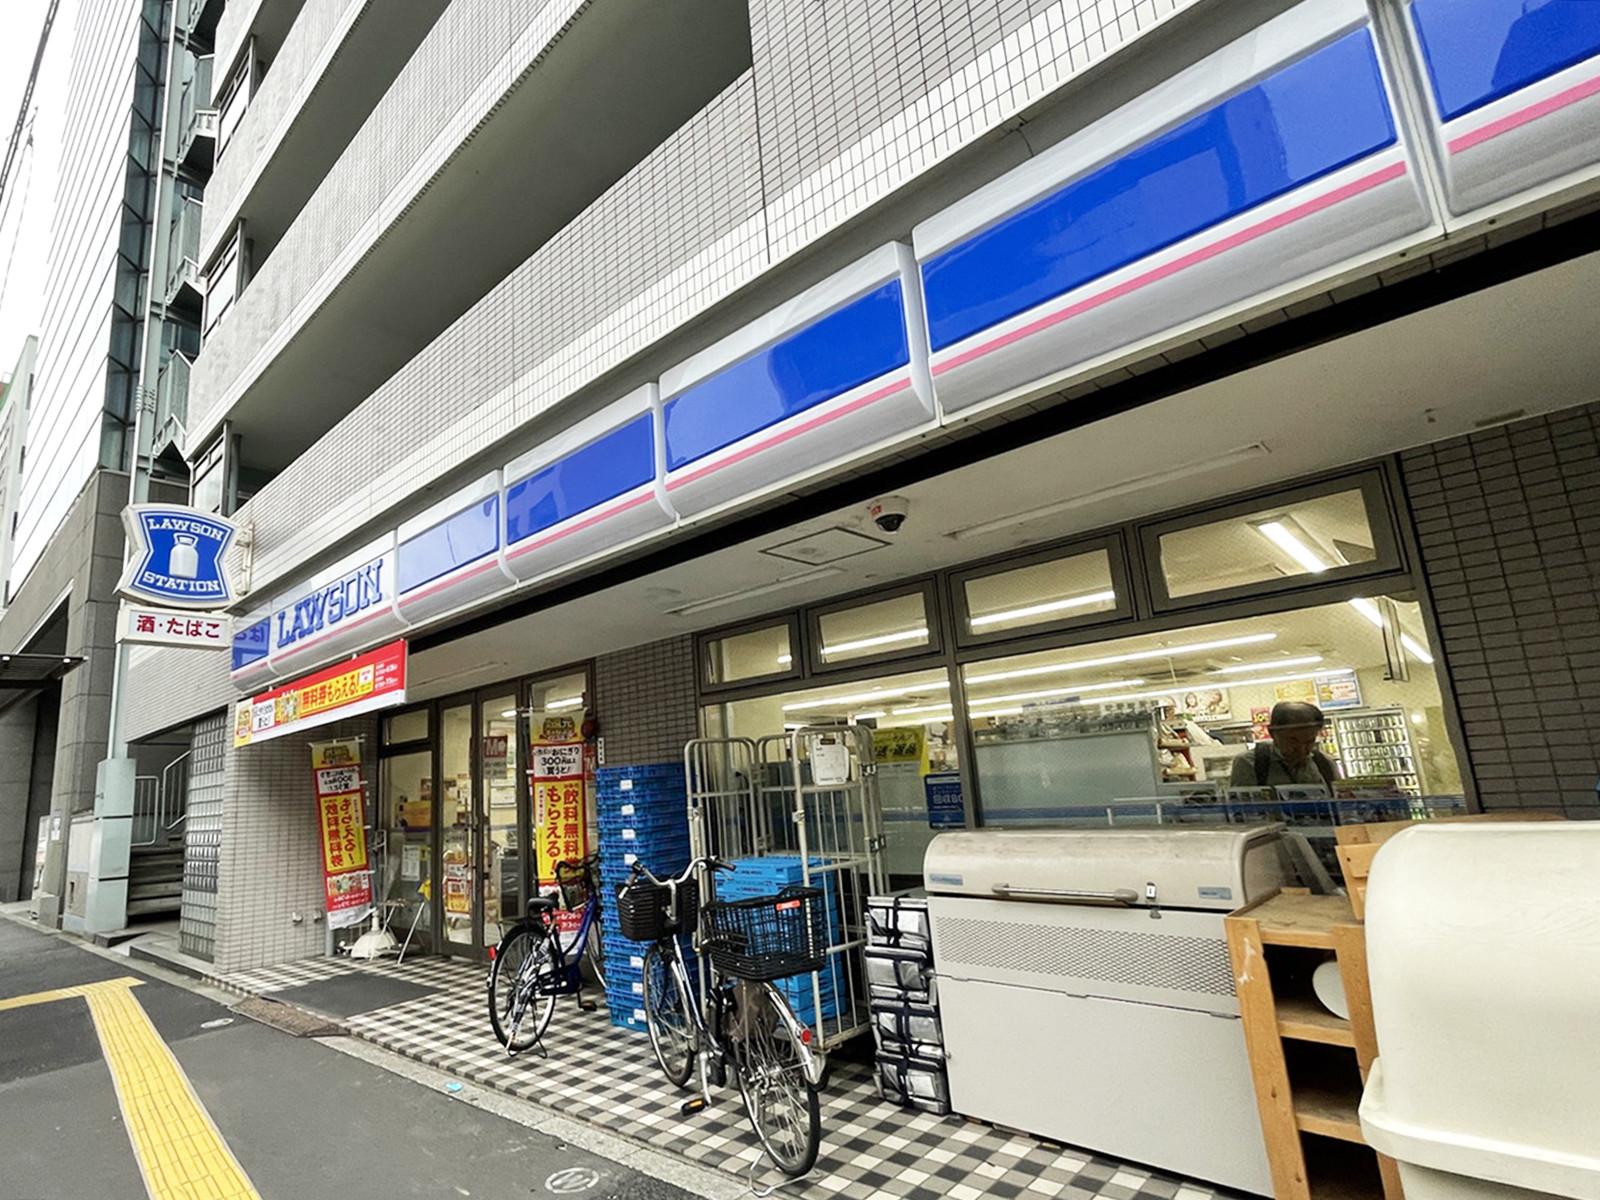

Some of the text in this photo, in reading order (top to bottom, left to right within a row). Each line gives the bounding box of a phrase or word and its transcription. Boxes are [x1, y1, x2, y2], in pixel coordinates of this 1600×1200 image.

[147, 517, 225, 542] LAWSON
[142, 570, 222, 593] STATION
[276, 558, 384, 649] LAWSON
[136, 614, 220, 639] 酒・たばこ
